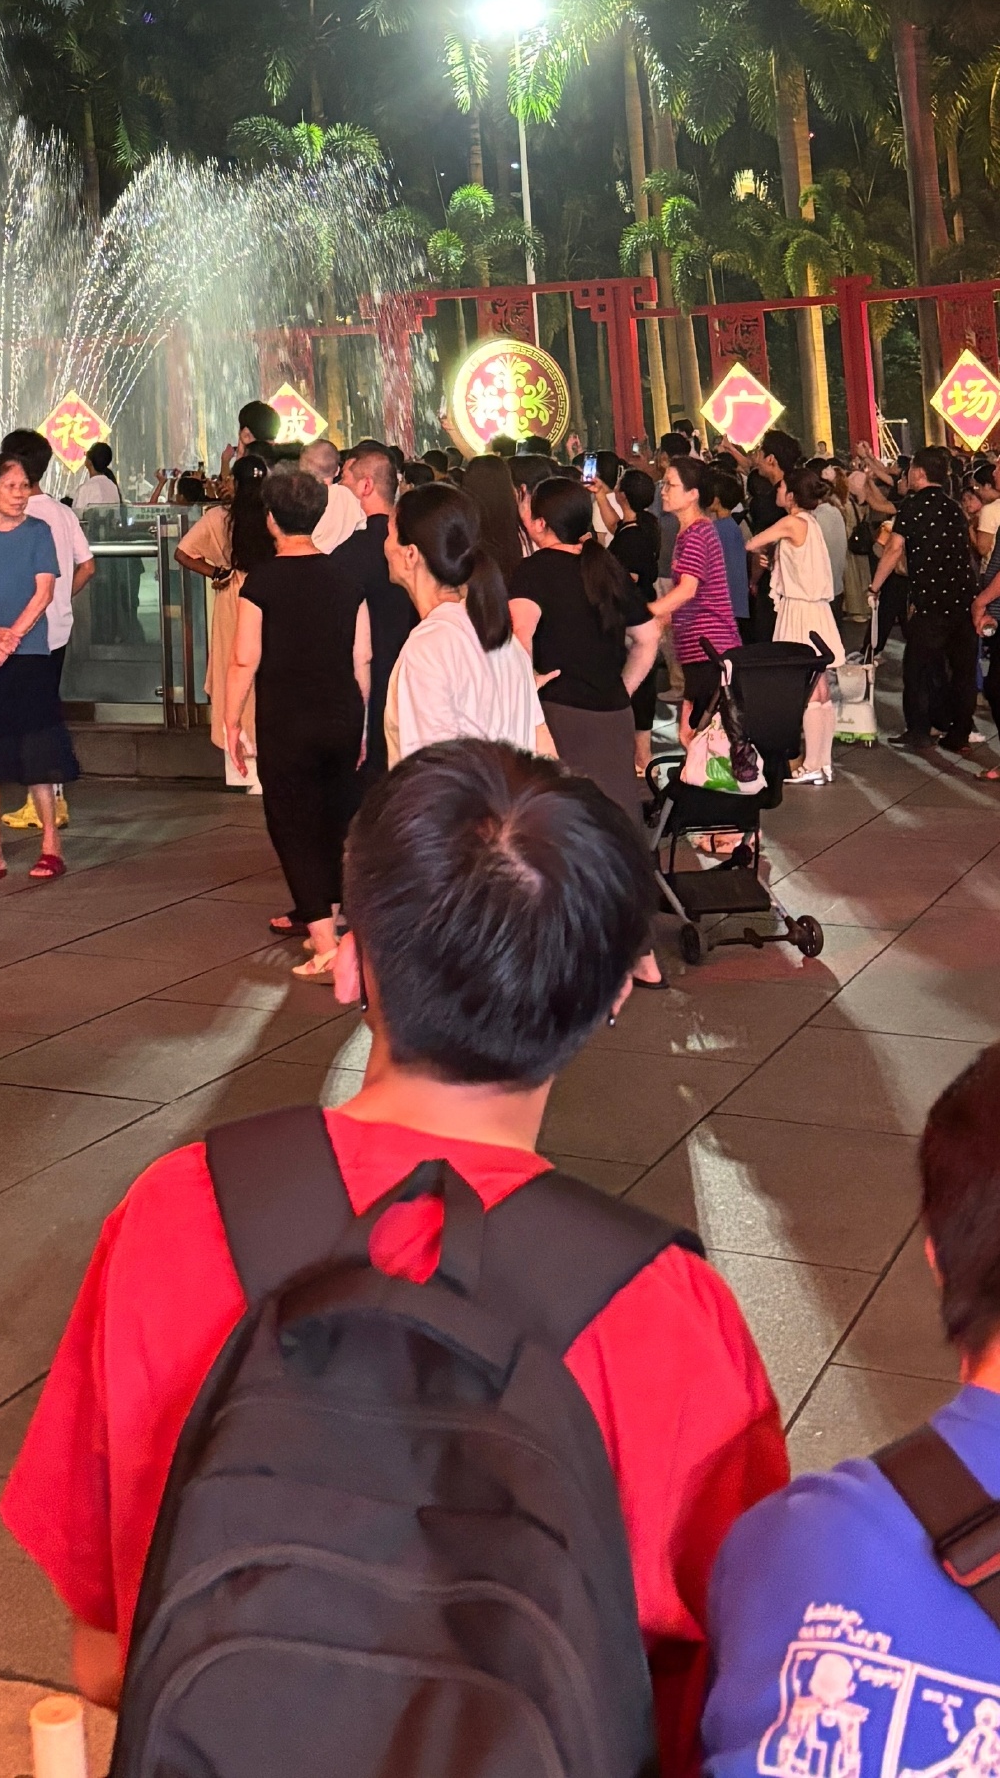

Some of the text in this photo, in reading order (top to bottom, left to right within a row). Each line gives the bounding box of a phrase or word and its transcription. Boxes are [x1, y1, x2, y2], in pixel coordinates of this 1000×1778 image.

[51, 413, 99, 450] 花
[718, 389, 767, 429] 广
[947, 379, 997, 421] 场
